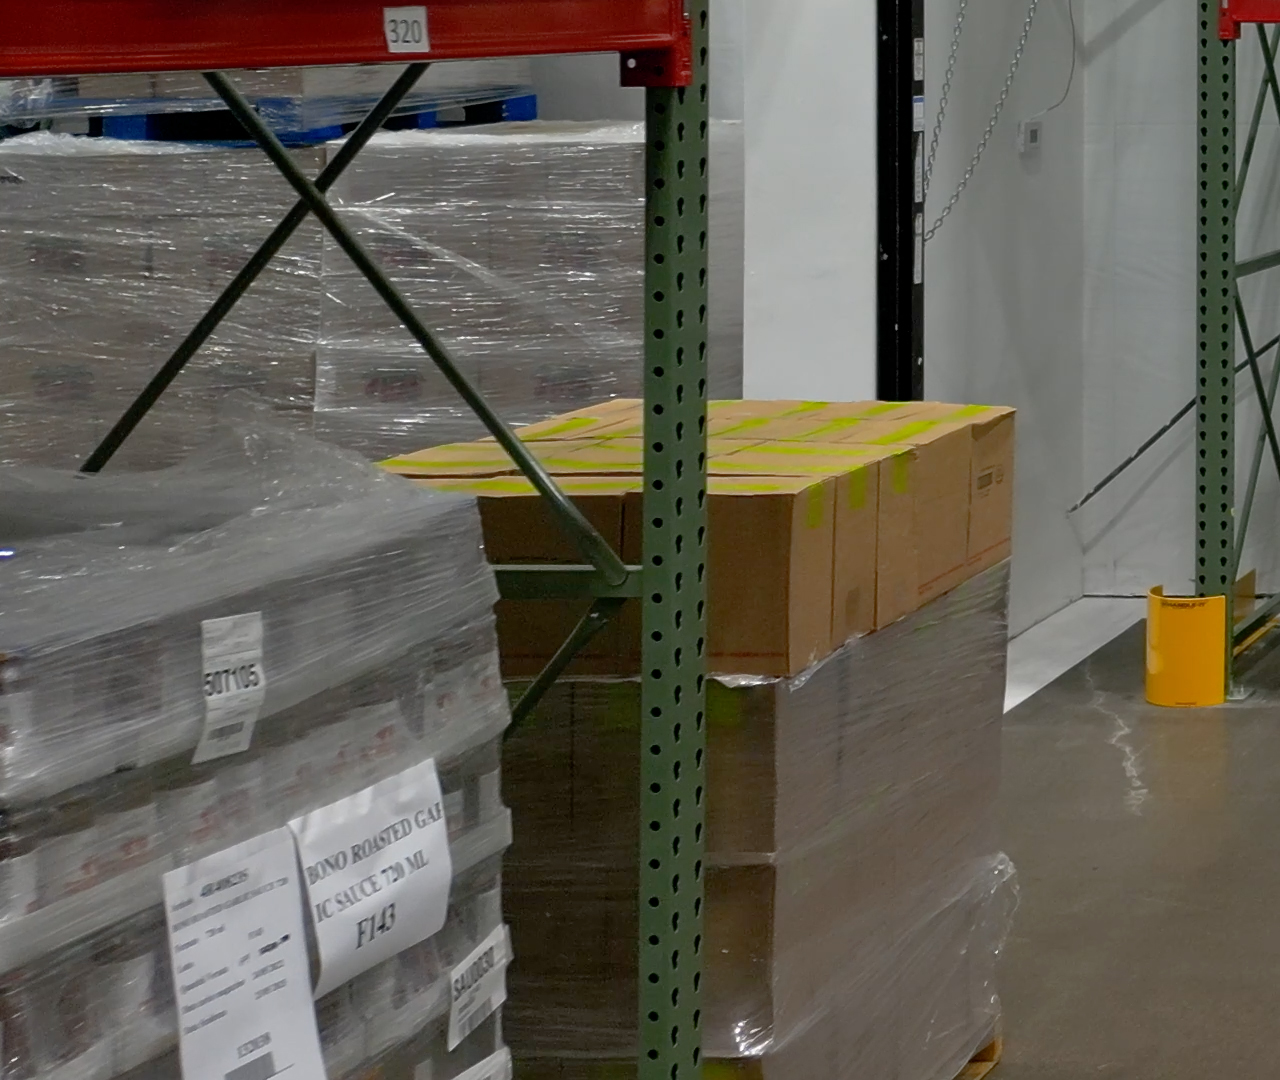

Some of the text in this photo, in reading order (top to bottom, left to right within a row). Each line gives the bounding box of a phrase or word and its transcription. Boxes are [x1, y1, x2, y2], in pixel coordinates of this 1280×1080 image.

[388, 19, 422, 44] 320
[204, 663, 260, 696] 507105
[305, 850, 348, 886] BONO
[350, 818, 412, 865] ROASTED
[314, 849, 430, 924] IC SAUCE 720 ML
[356, 901, 396, 950] F143
